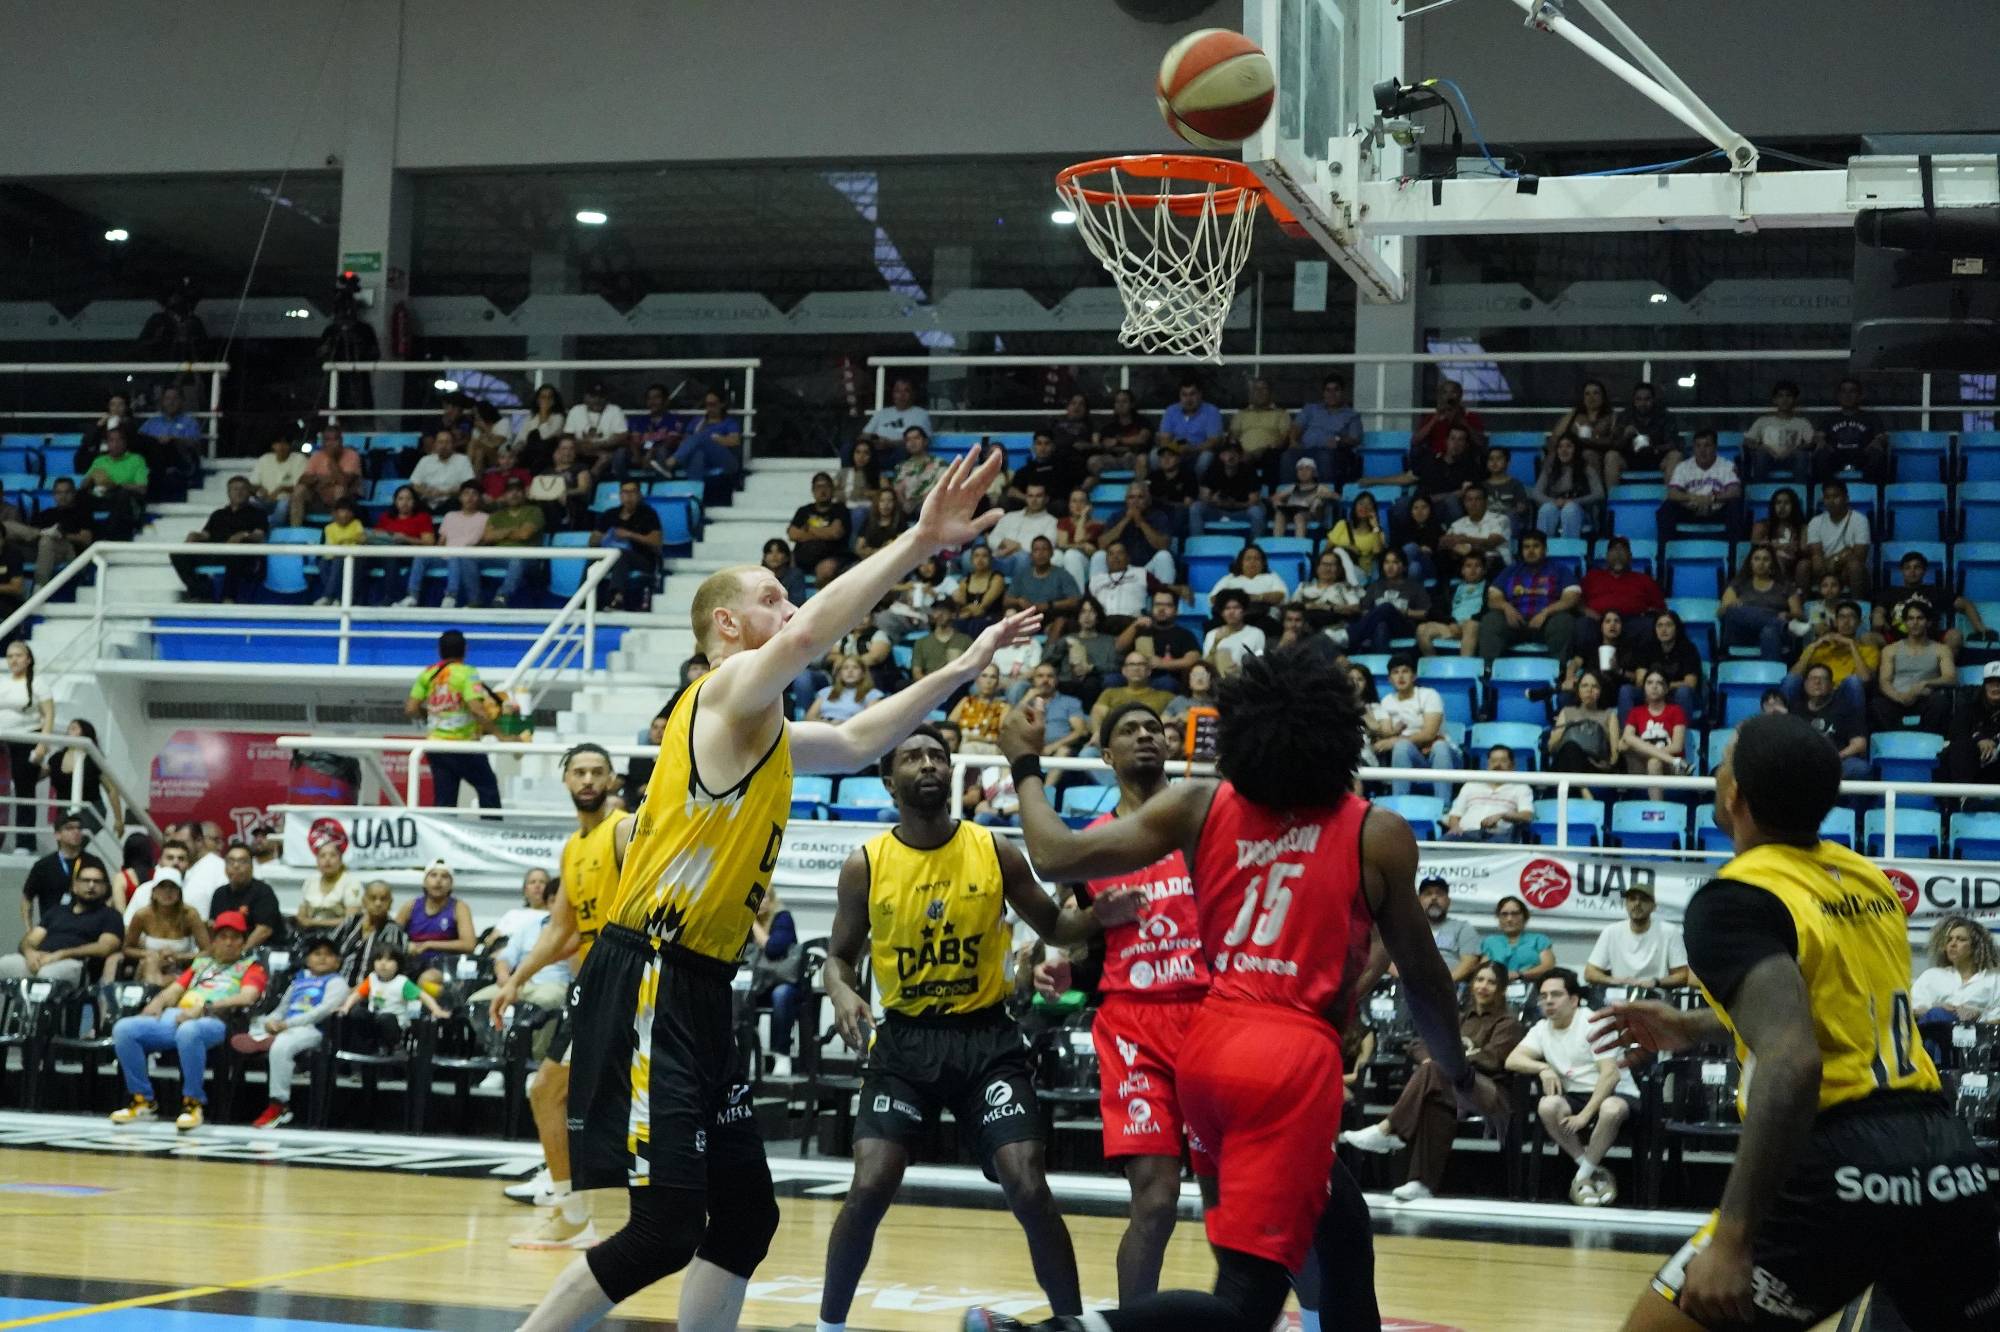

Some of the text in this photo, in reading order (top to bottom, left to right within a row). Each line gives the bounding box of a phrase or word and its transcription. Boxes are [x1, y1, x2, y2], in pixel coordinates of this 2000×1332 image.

[351, 817, 417, 849] UAD
[791, 842, 855, 853] GRANDES
[1577, 863, 1656, 898] UAD
[1224, 863, 1305, 946] 15
[893, 932, 984, 981] CABS
[983, 1103, 1026, 1125] MEGA
[1123, 1120, 1161, 1136] MEGA
[1834, 1162, 1988, 1206] Soni Gas
